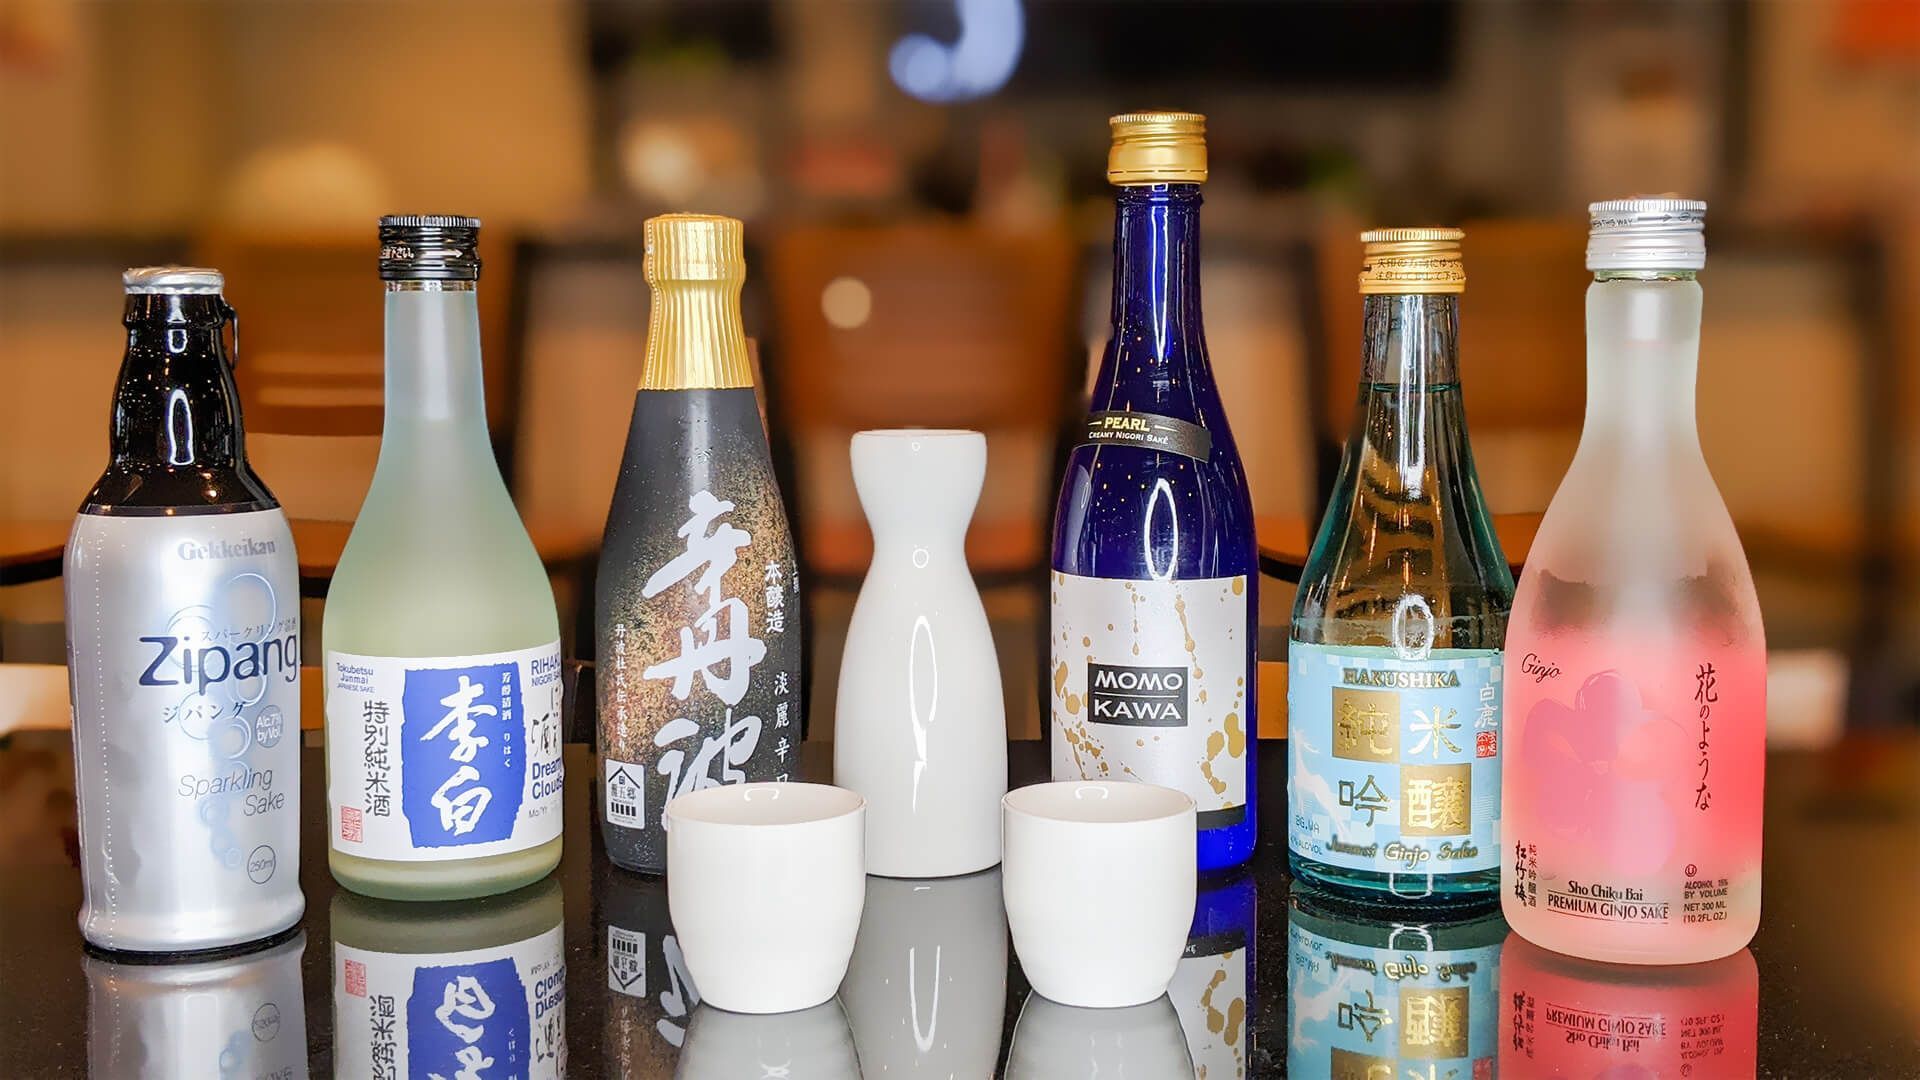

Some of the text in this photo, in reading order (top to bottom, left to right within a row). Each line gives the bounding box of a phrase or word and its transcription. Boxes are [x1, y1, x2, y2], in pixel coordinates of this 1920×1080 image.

[1104, 416, 1151, 432] PEARL
[177, 537, 277, 562] Gekkeikan
[138, 631, 297, 696] Zipang
[1521, 652, 1562, 683] Ginjo
[1094, 669, 1183, 691] MOMO
[1343, 667, 1461, 689] HAKUSHIKA
[162, 699, 246, 724] ジパング
[1094, 699, 1182, 721] KAWA
[1695, 662, 1719, 811] 花のような
[363, 700, 392, 818] 特別純米酒
[419, 674, 498, 837] 李白
[177, 766, 273, 801] Sparkling
[243, 789, 285, 817] Sake
[1384, 840, 1431, 870] Ginjo
[1568, 880, 1643, 901] Sho Chiku Bai
[1684, 887, 1728, 899] BY VOLUME
[1548, 893, 1669, 920] PREMIUM GINJO SAKE
[1683, 902, 1701, 912] NET
